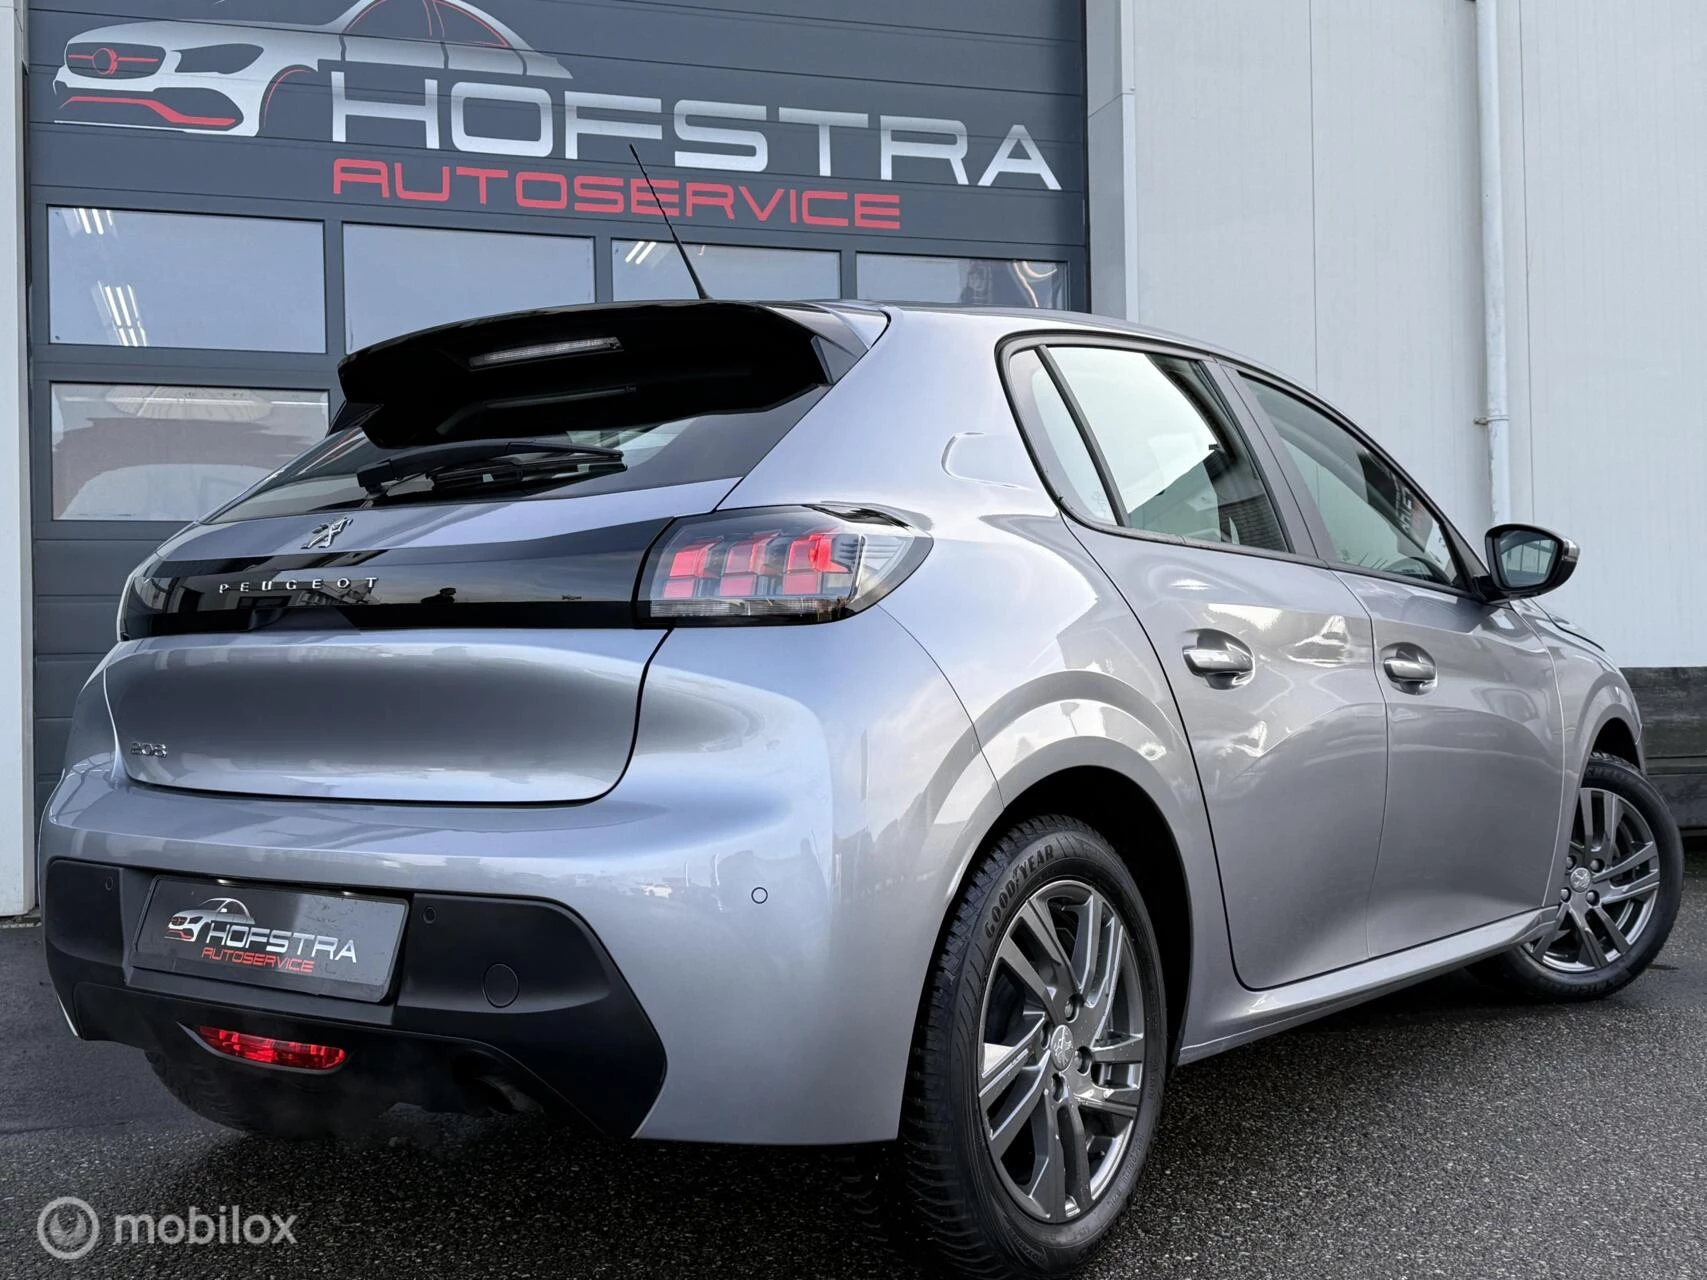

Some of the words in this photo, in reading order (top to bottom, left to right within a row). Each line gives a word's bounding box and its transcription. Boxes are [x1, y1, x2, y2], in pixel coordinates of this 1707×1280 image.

[331, 71, 1062, 191] HOFSTRA
[333, 159, 901, 230] AUTOSERVICE
[219, 577, 378, 594] PEUGEOT
[130, 742, 168, 758] 208
[201, 947, 315, 973] AUTOSERVICE
[205, 923, 357, 964] HOFSTRA
